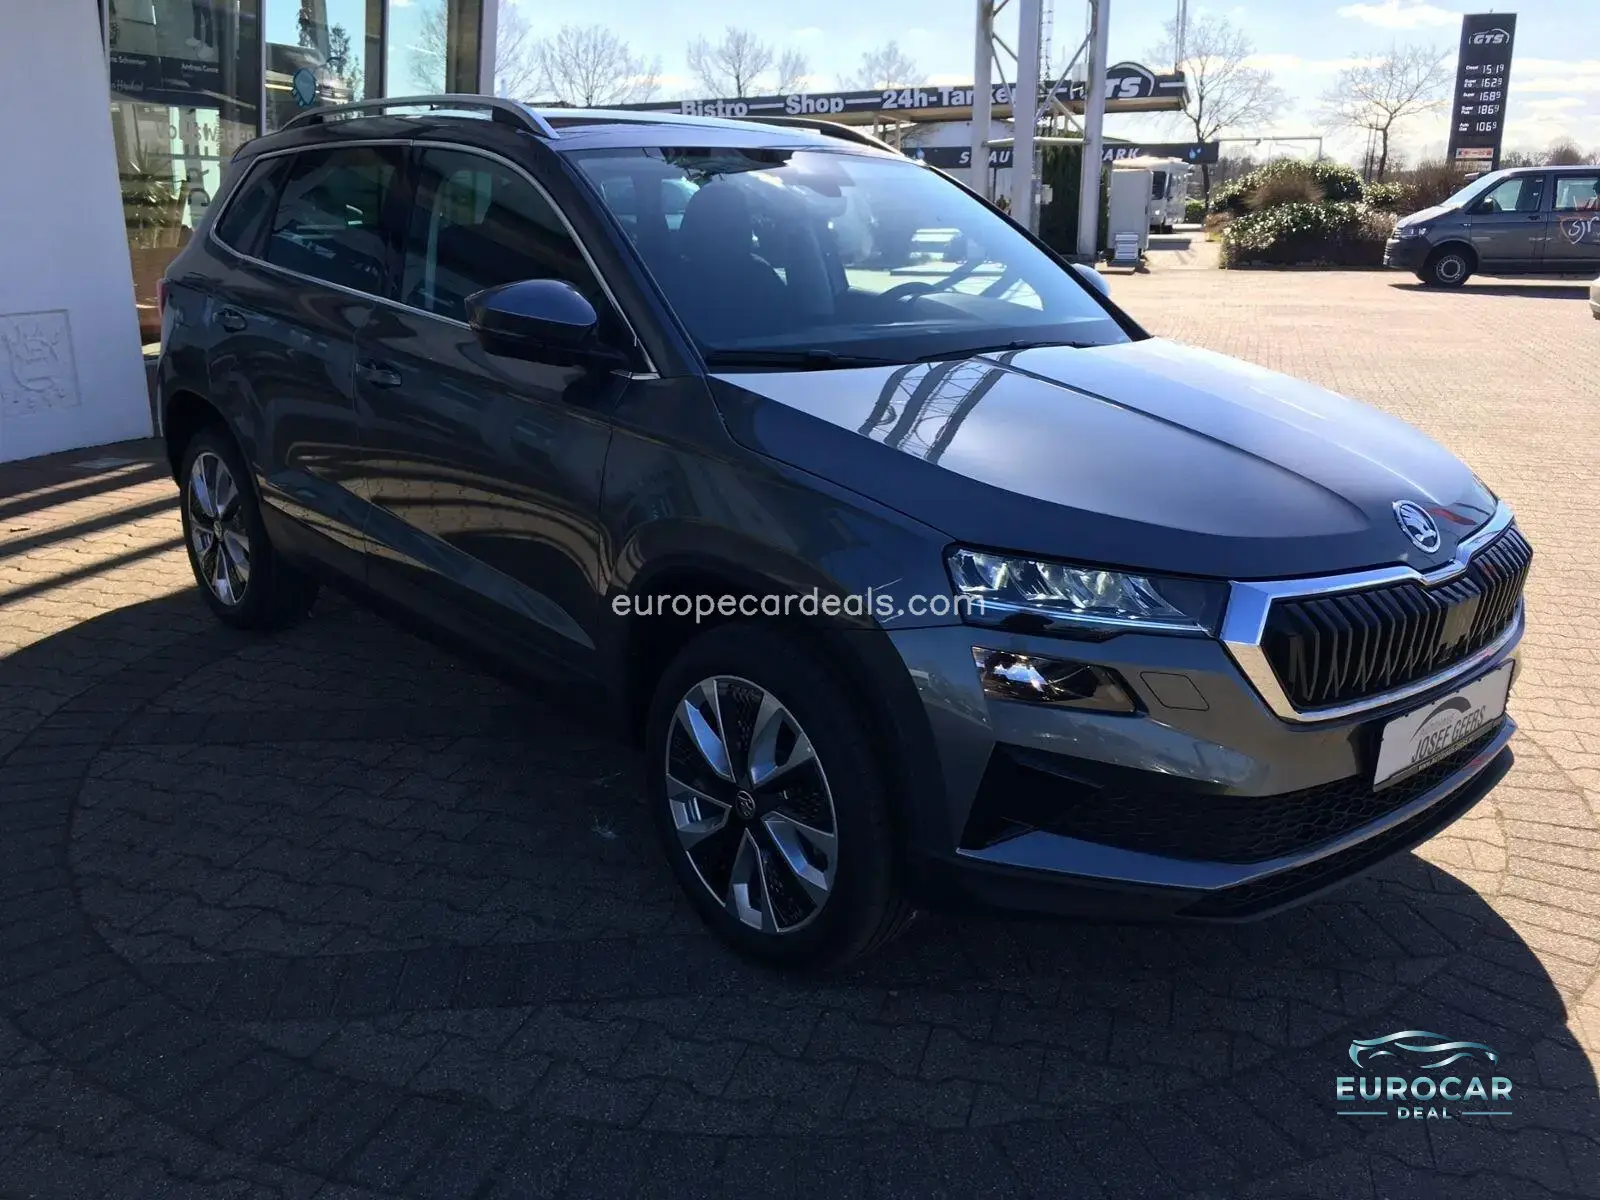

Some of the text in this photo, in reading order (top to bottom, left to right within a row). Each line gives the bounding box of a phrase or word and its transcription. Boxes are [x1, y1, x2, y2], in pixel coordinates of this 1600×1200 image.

[1473, 34, 1504, 44] GTS
[681, 86, 1017, 116] Bistro Shop 24h-Tane
[988, 151, 1013, 163] AU
[1411, 724, 1452, 762] JOSEF
[1452, 705, 1486, 741] GEERS
